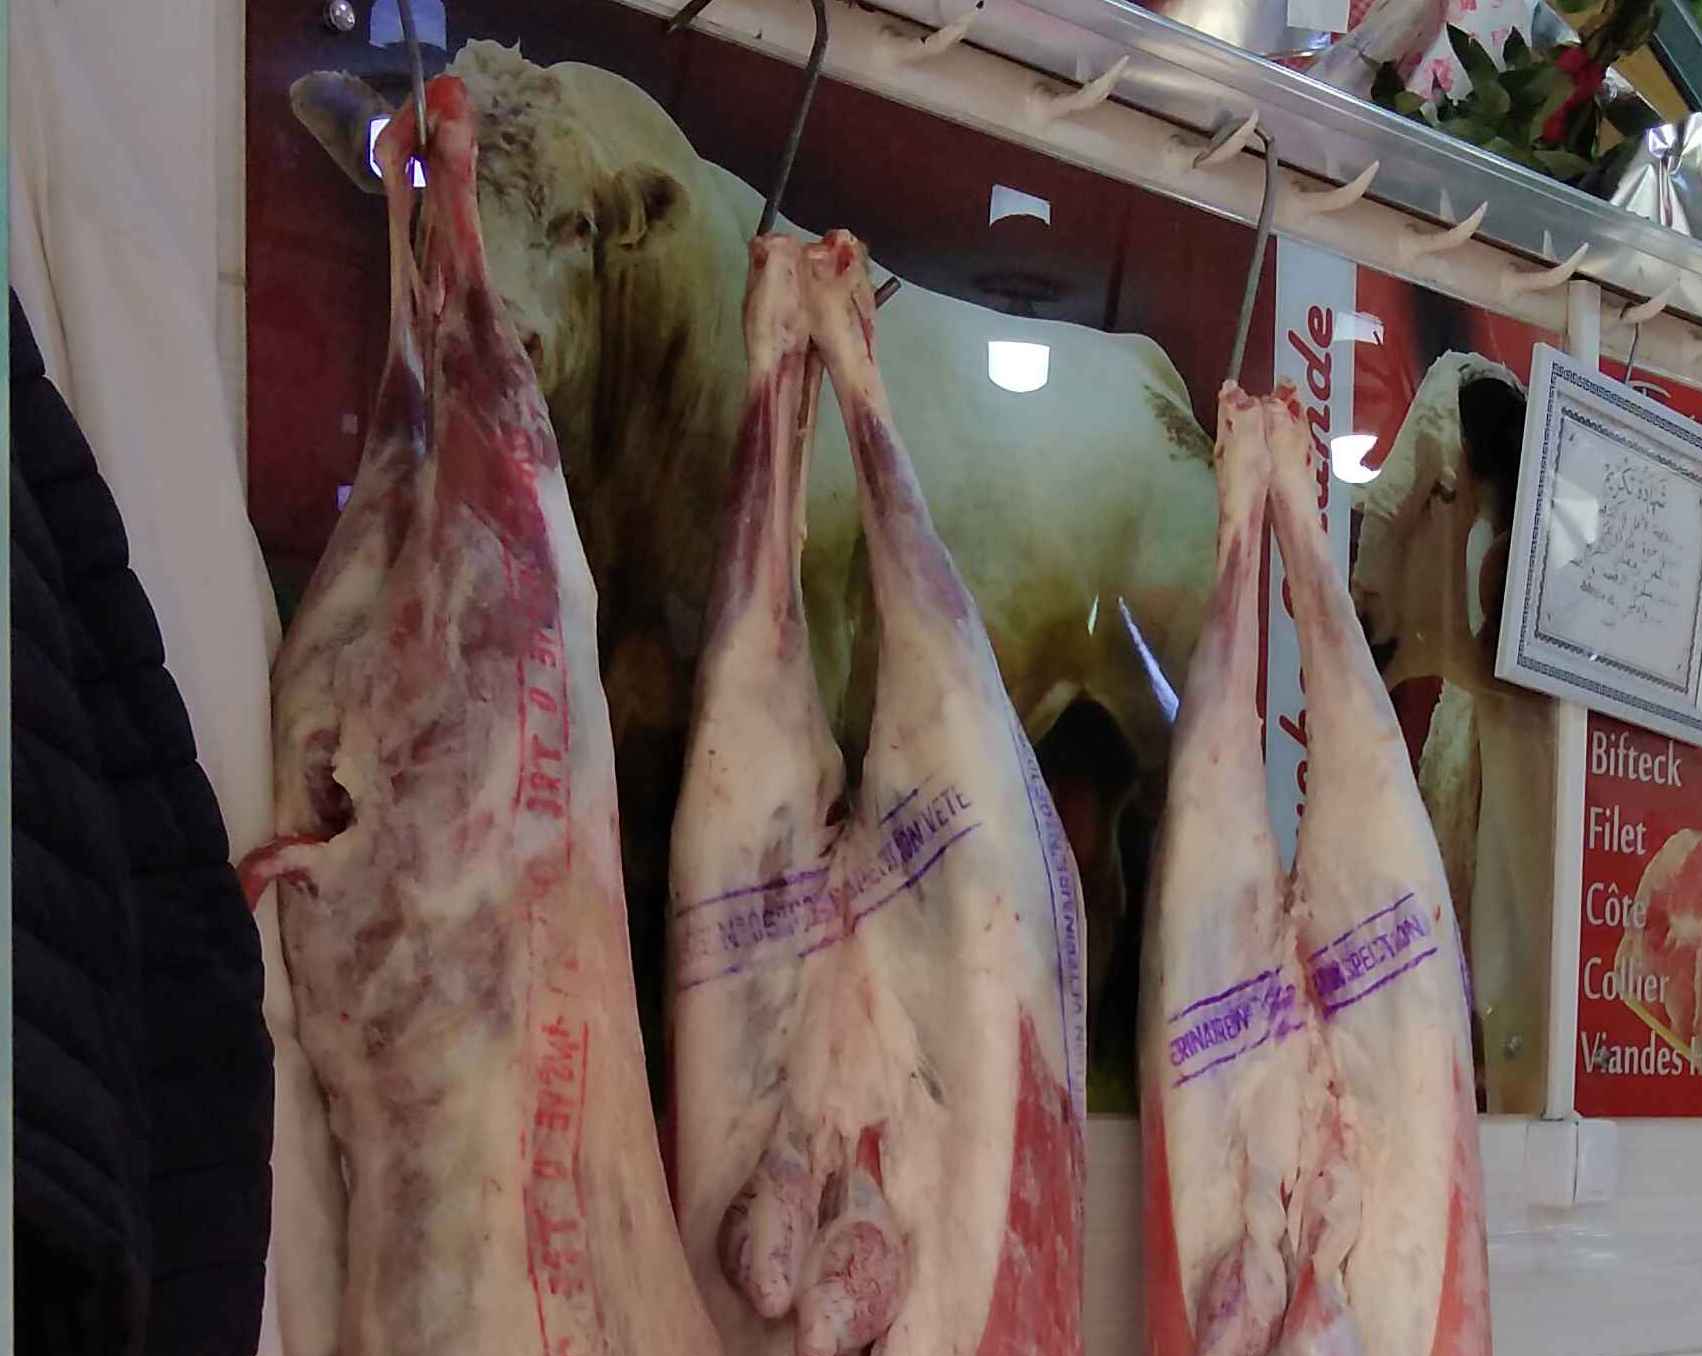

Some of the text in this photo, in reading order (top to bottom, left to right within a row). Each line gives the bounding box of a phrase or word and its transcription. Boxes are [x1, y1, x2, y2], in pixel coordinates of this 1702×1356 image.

[1590, 731, 1682, 787] Bifteck
[1588, 807, 1646, 856] Filet
[1586, 883, 1647, 929] Côte
[1584, 957, 1671, 1003] Collier
[1581, 1029, 1682, 1076] Viandes
